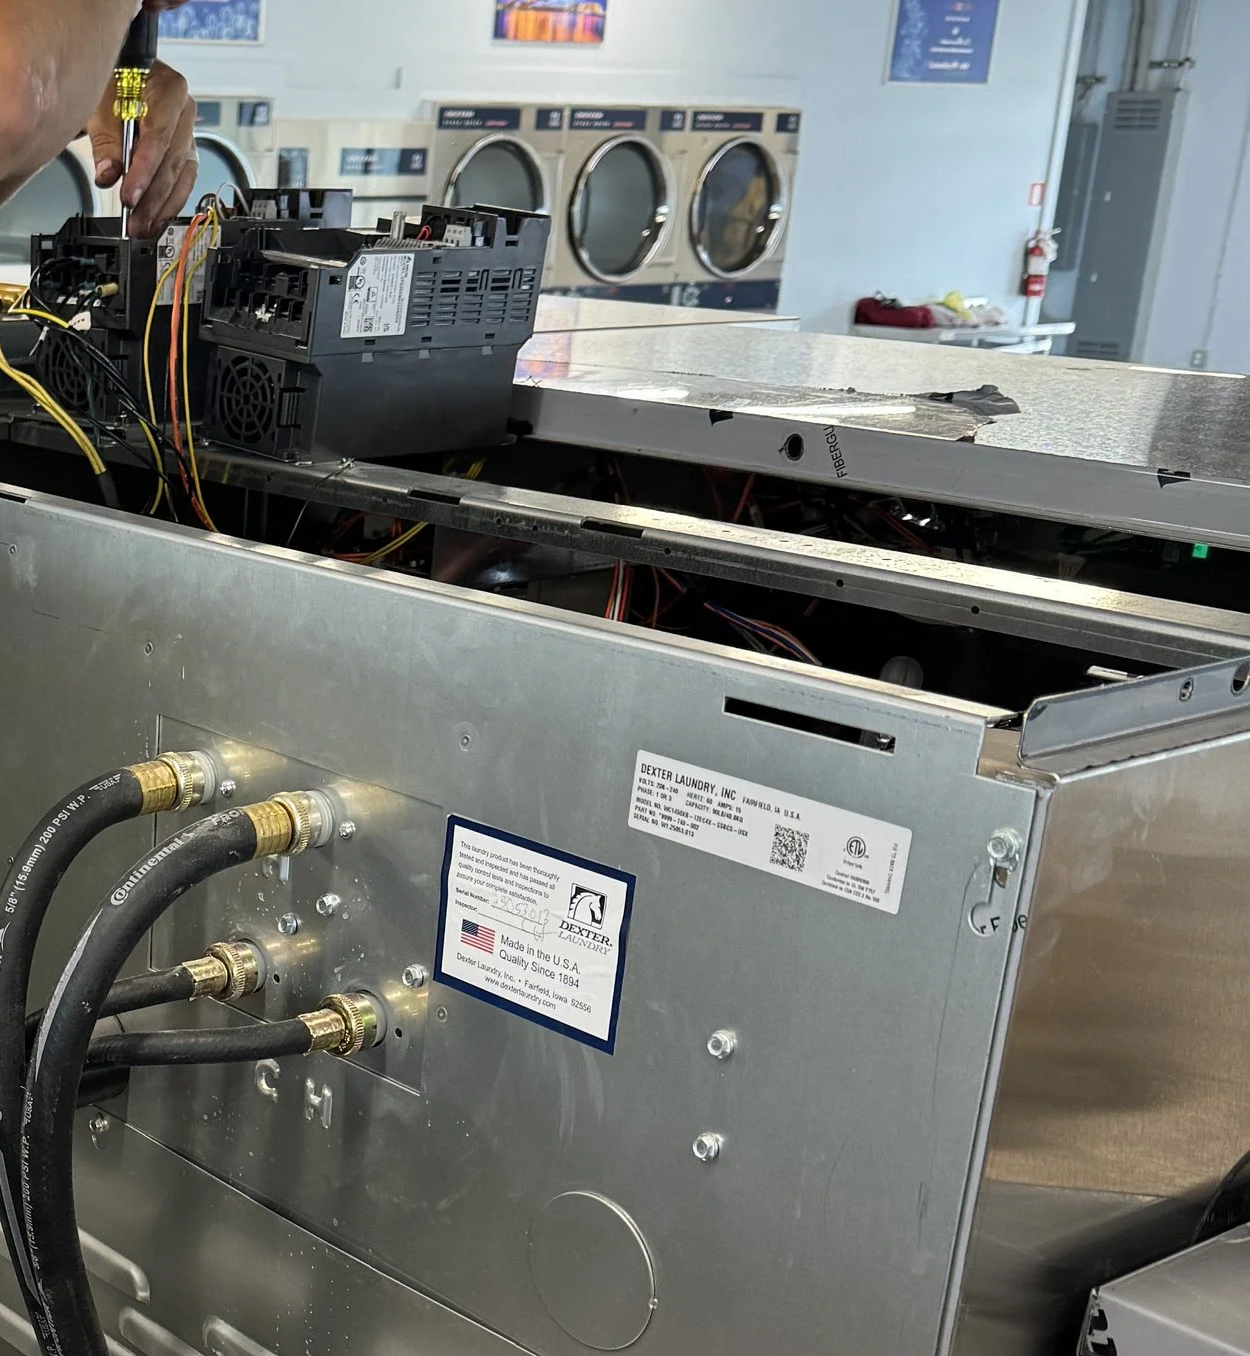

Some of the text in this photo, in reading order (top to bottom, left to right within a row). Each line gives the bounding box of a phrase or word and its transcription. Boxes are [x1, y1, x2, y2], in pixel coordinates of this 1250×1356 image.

[637, 786, 654, 798] PHASE:
[641, 763, 672, 781] DEXTER
[675, 773, 718, 796] LAUNDRY,
[721, 787, 737, 800] INC
[742, 796, 772, 814] FAIRFIELD,
[634, 805, 648, 815] PART
[14, 844, 46, 891] (15.9mm)
[40, 826, 56, 844] 200
[52, 810, 70, 826] PSI
[66, 794, 90, 811] W.P.
[110, 838, 184, 906] Continental
[458, 862, 474, 874] quality
[474, 866, 491, 878] control
[492, 871, 504, 882] tests
[504, 876, 514, 886] and
[514, 880, 543, 897] inspections
[459, 851, 474, 862] tested
[475, 856, 485, 865] and
[485, 859, 509, 874] inspected
[509, 866, 519, 876] and
[529, 874, 548, 888] passed
[460, 840, 560, 883] This laundry product has been thoroughly
[454, 899, 478, 913] Inspector:
[456, 872, 538, 905] assure your complete satisfaction.
[470, 892, 490, 904] Number:
[500, 934, 581, 974] Made in the U.S.A.
[558, 931, 611, 955] LAUNDRY
[456, 952, 592, 1014] Dexter Laundry, Inc. Fairfield, Iowa 52556
[500, 949, 579, 988] Quality Since 1894
[484, 976, 556, 1010] www.dexterlaundry.com
